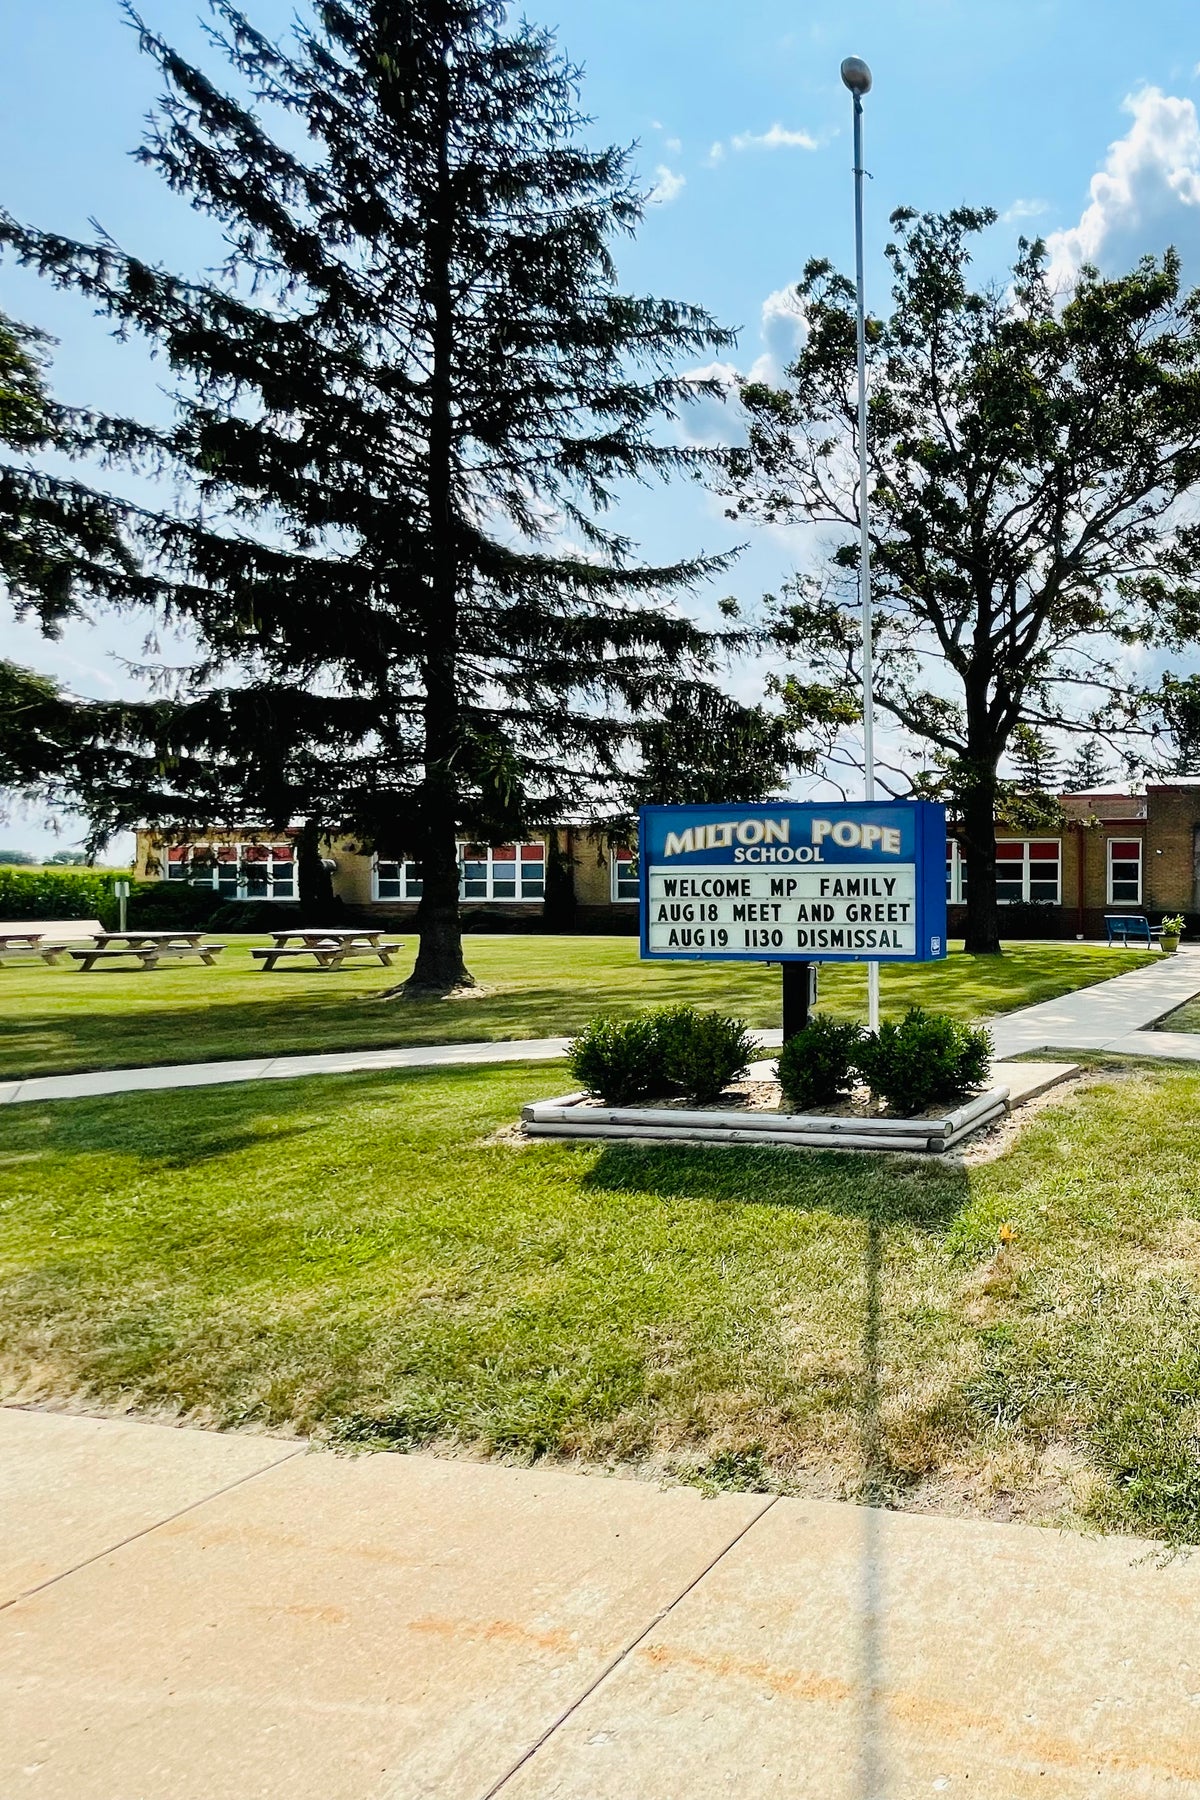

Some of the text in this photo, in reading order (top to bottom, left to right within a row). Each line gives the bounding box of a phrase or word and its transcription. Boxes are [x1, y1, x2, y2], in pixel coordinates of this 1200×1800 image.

[663, 818, 901, 858] MILTON POPE
[733, 846, 825, 863] SCHOOL
[663, 877, 897, 897] WELCOME MP FAMILY
[732, 903, 782, 922] MEET
[797, 903, 835, 922] AND
[845, 903, 911, 922] GREET
[744, 928, 784, 947] 1130
[797, 929, 903, 948] DISMISSAL
